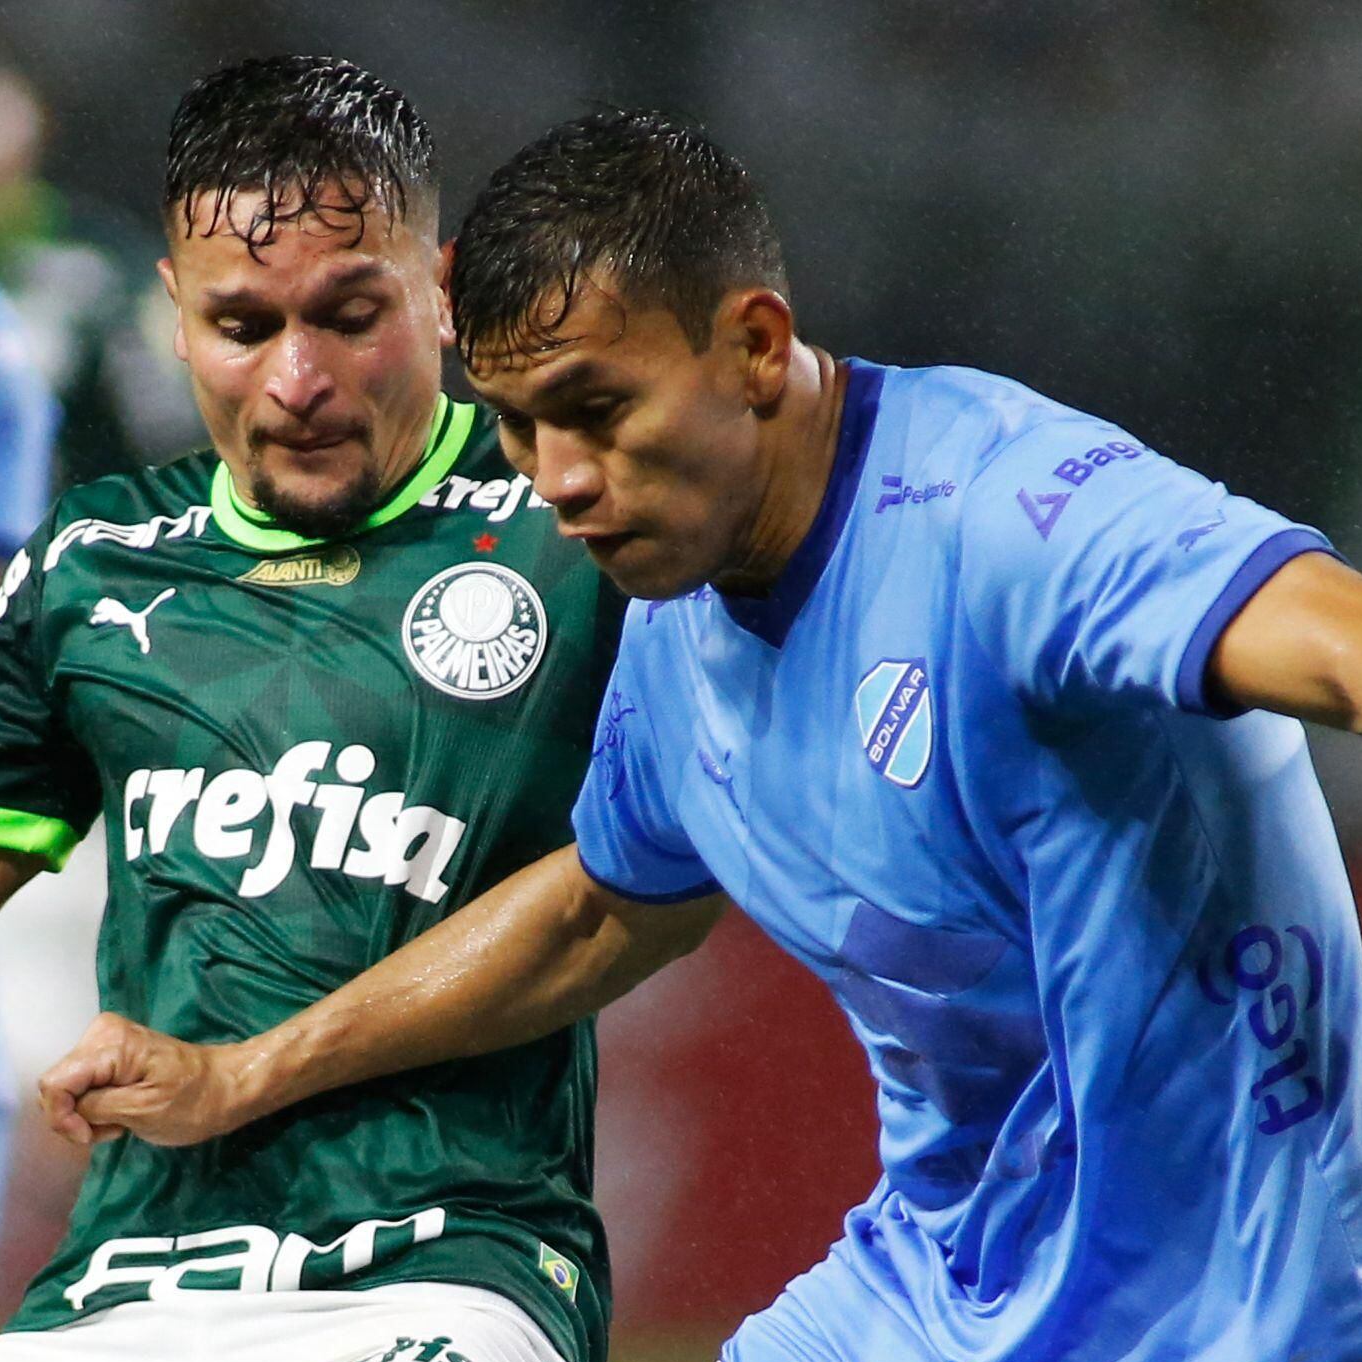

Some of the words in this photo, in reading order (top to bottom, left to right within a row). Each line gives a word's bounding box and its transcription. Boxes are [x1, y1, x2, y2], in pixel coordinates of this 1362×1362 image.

[1053, 441, 1142, 486] Bag
[412, 618, 538, 690] PALMEIRAS
[868, 667, 926, 763] BOLIVAR
[124, 740, 467, 904] crefisa
